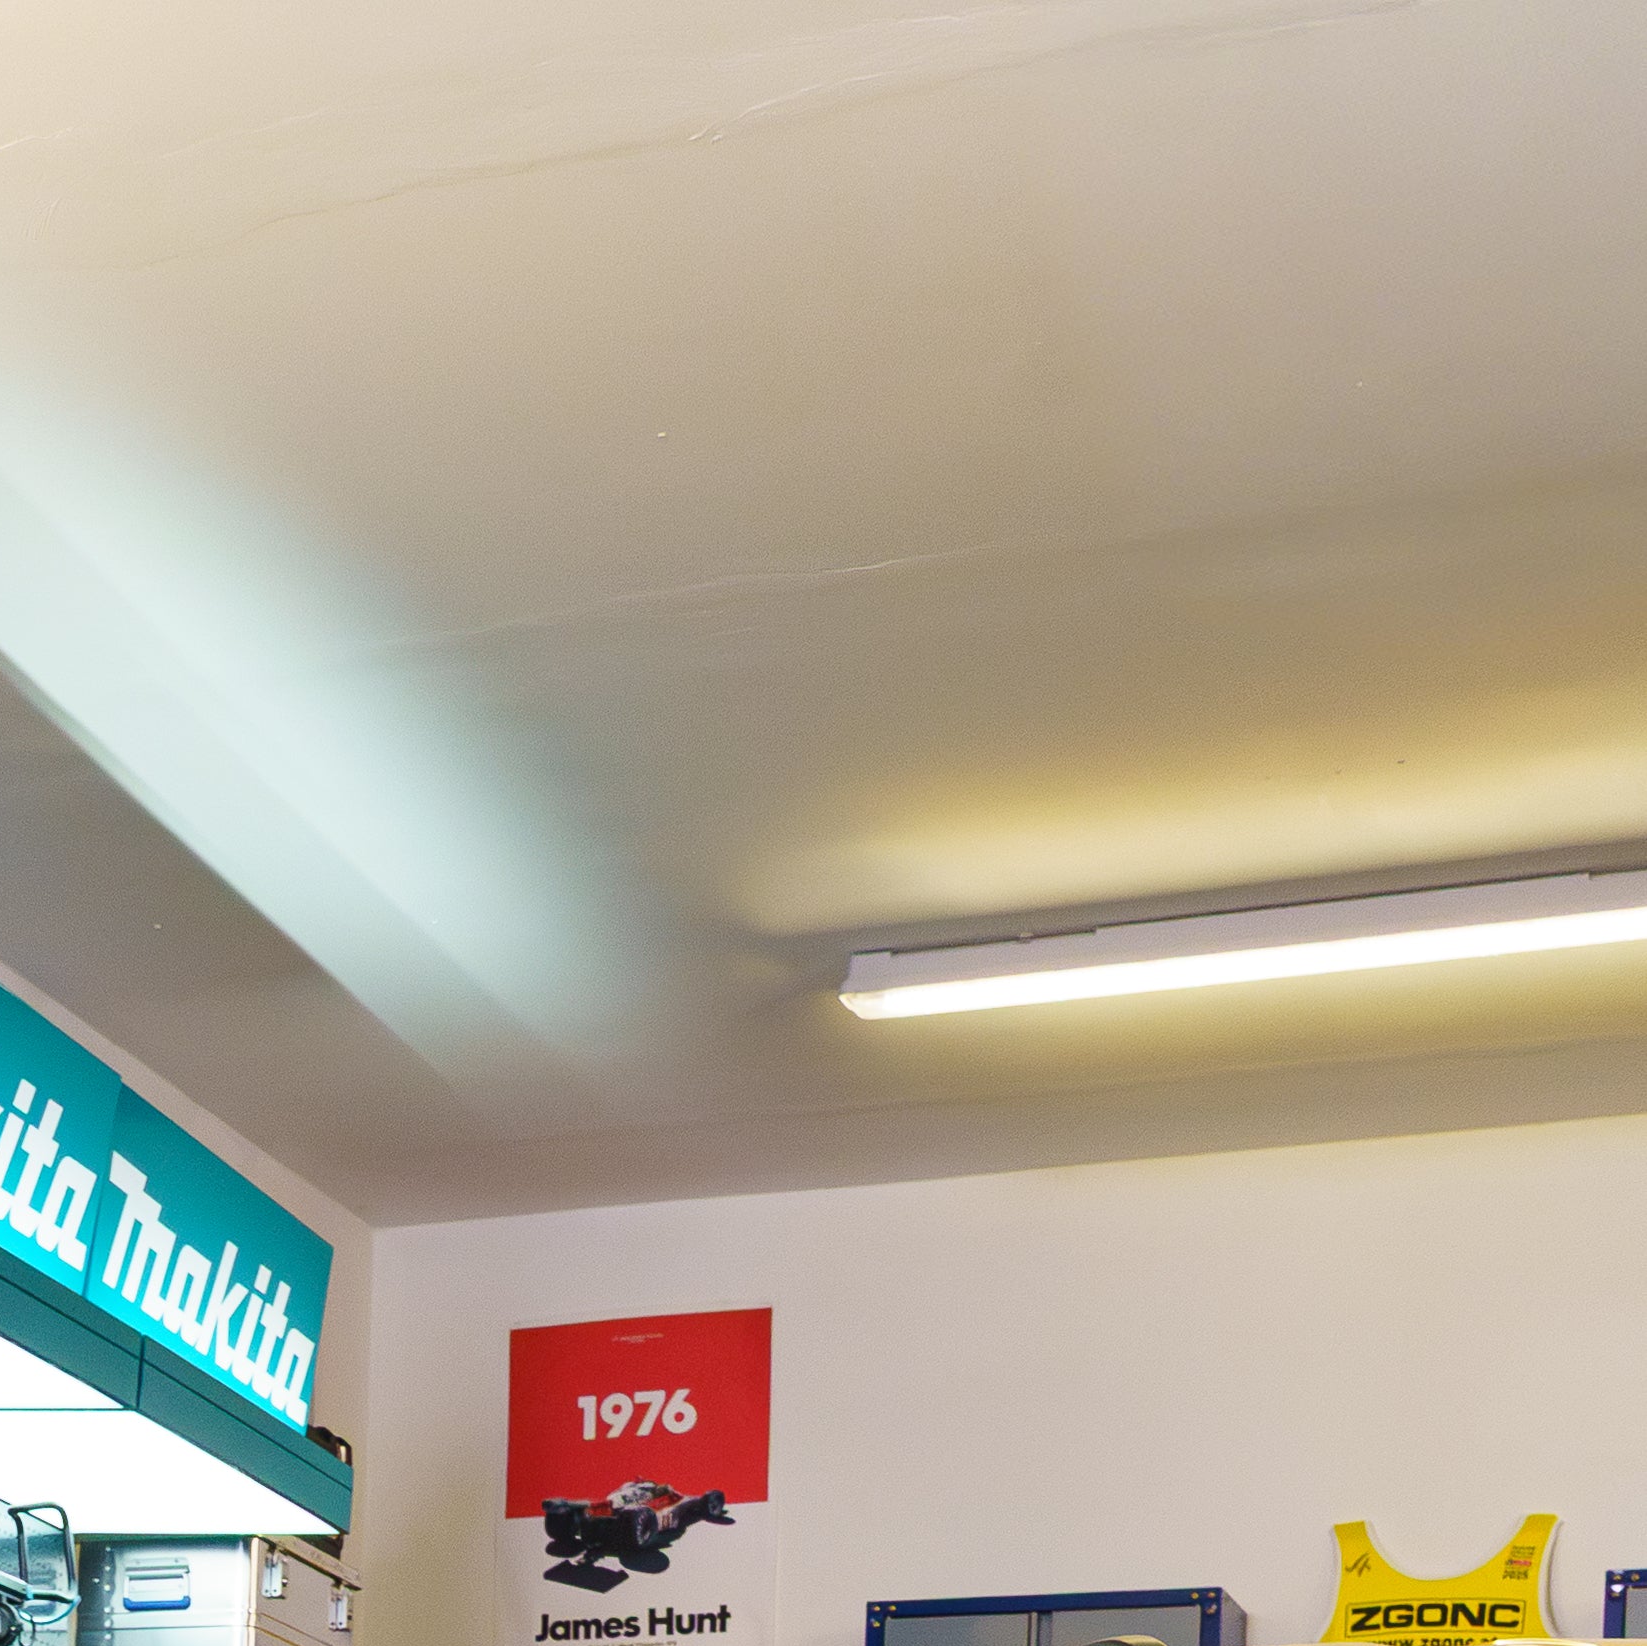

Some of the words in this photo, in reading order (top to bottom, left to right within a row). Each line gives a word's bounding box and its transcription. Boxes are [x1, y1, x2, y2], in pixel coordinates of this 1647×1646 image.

[578, 1388, 698, 1441] 1976
[535, 1614, 641, 1642] James
[648, 1605, 732, 1636] Hunt
[1351, 1603, 1521, 1632] ZGONC
